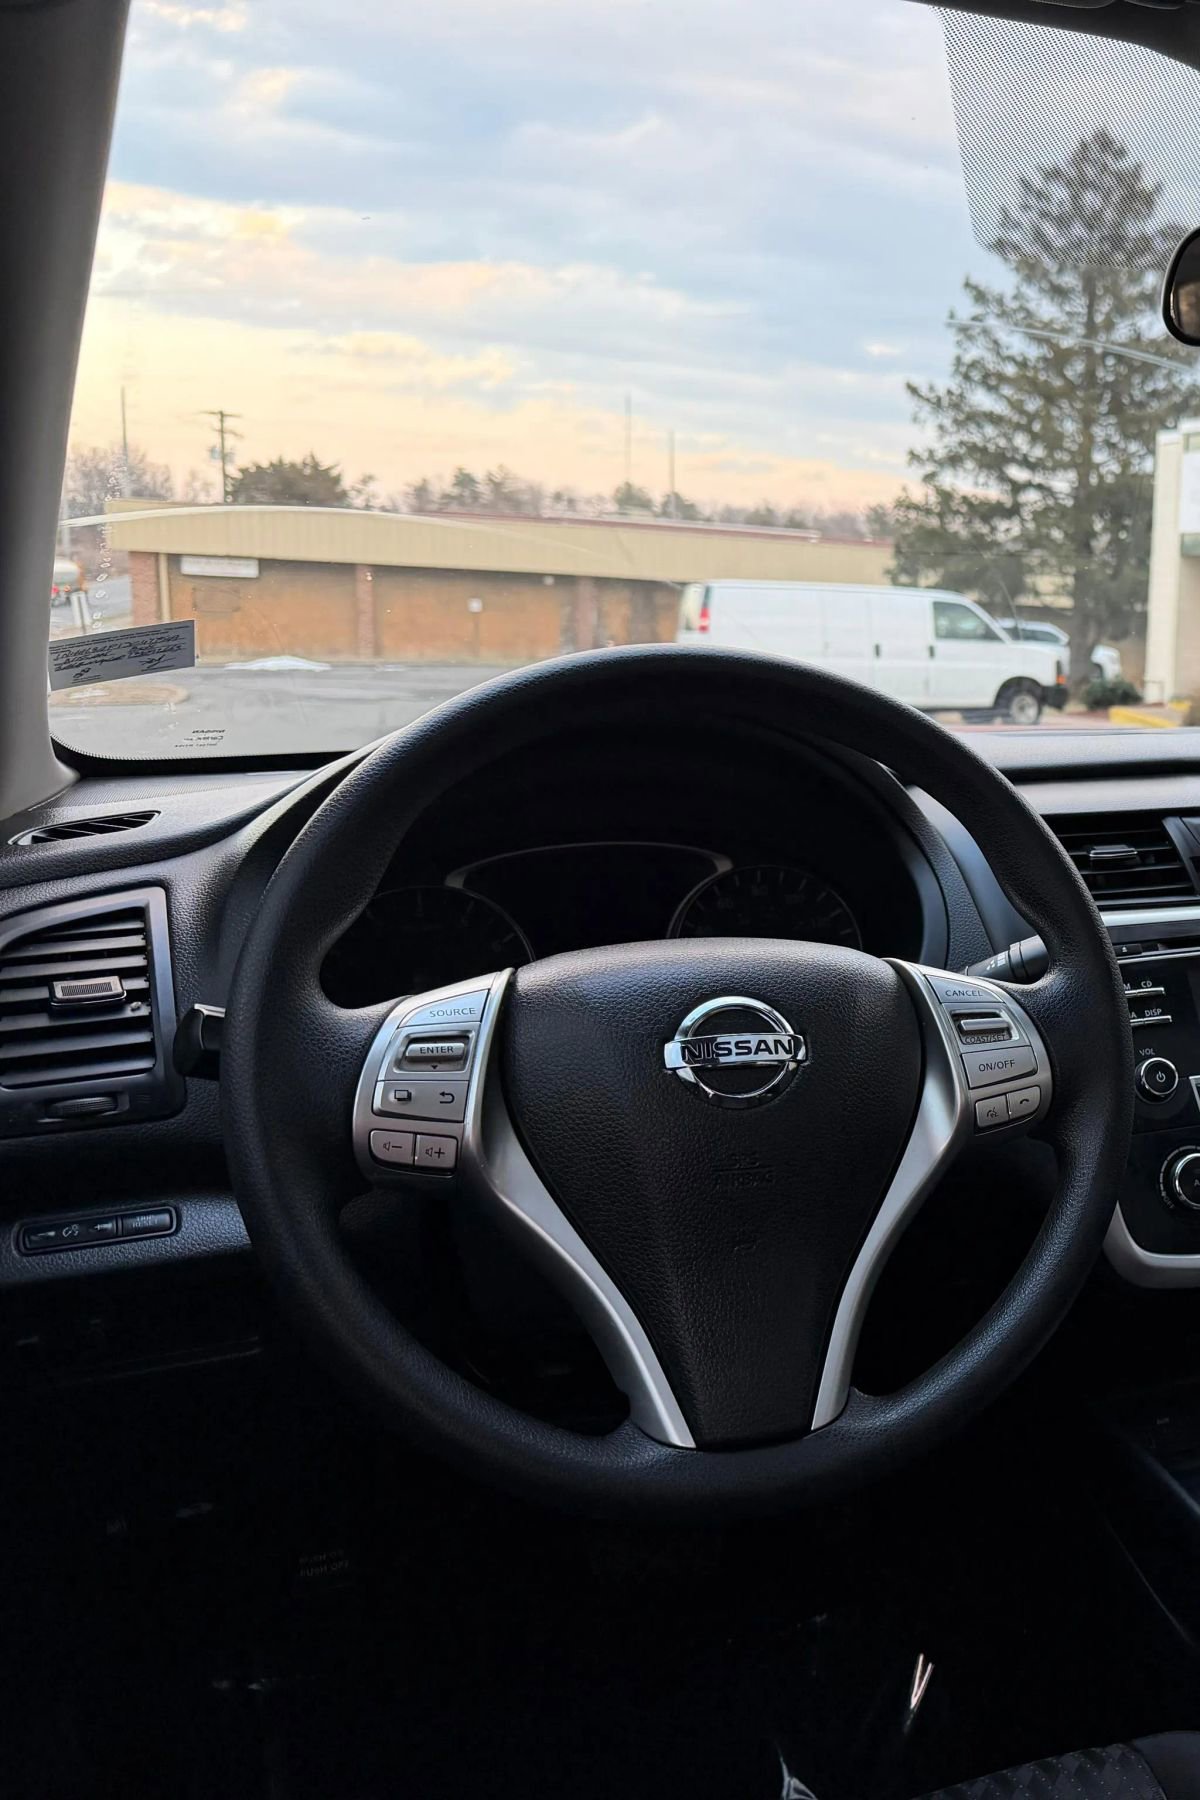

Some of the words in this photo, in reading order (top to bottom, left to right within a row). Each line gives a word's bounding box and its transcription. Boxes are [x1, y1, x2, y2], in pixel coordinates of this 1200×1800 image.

[1141, 980, 1152, 988] CD
[945, 989, 984, 997] CANCEL
[429, 1007, 477, 1018] SOURCE
[1144, 1008, 1162, 1017] DISP
[420, 1045, 454, 1055] ENTER
[682, 1038, 795, 1062] NISSAN
[1139, 1048, 1155, 1056] VOL
[978, 1060, 1016, 1072] ON/OFF
